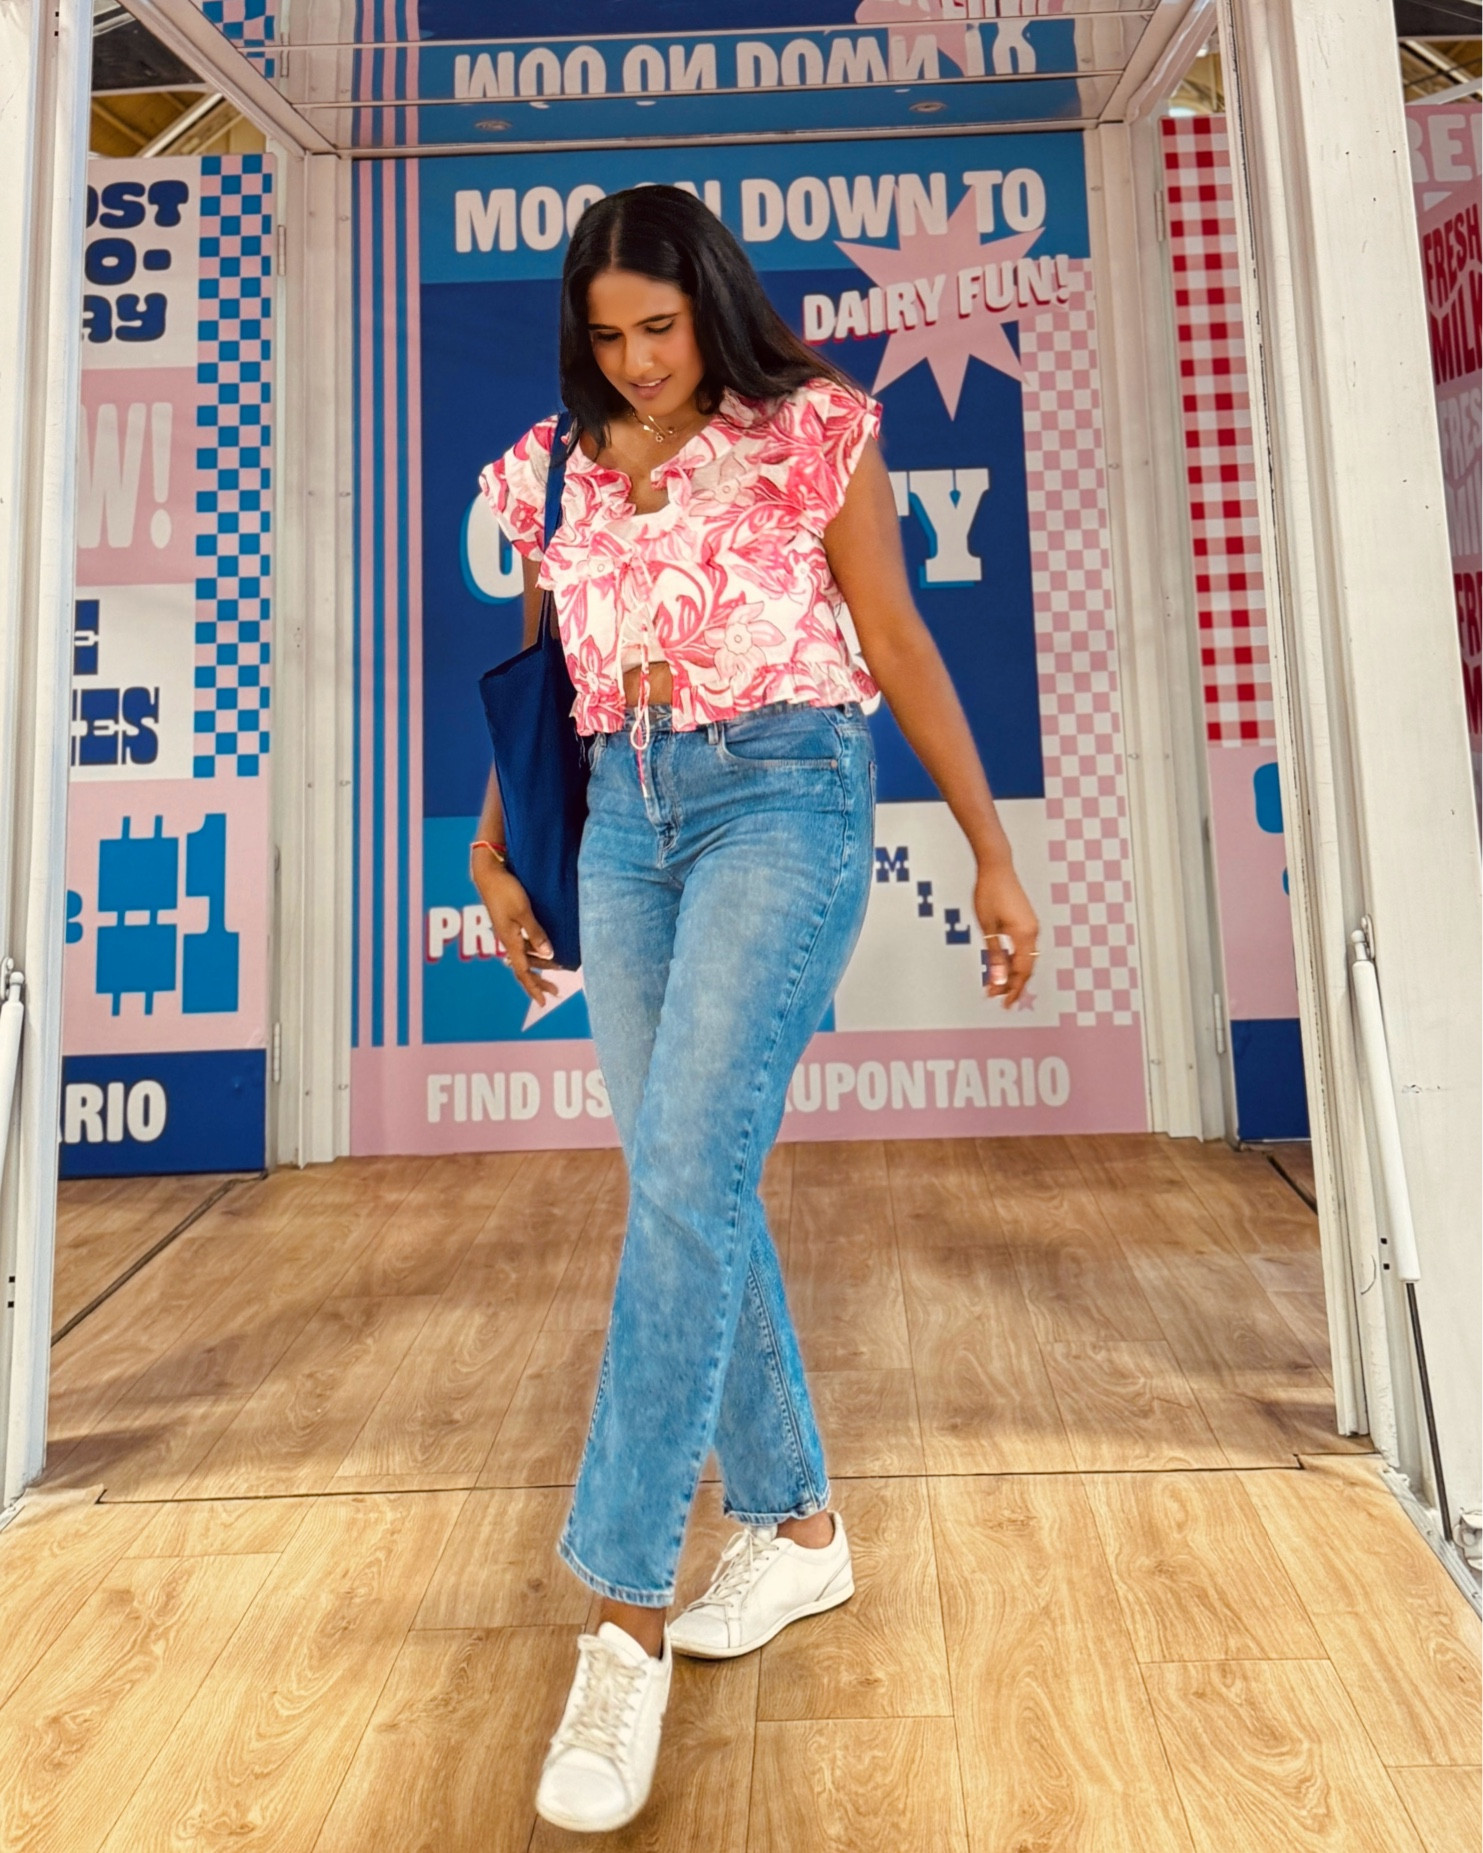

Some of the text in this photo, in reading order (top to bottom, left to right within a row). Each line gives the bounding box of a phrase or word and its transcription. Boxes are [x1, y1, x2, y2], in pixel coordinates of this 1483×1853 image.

[86, 180, 189, 229] ST
[741, 172, 948, 242] DOWN
[963, 168, 1046, 233] TO
[803, 254, 1069, 346] DAIRY FUN!
[71, 686, 160, 767] ES
[58, 1080, 167, 1144] RIO
[427, 1056, 1070, 1123] FIND US UPONTARIO
